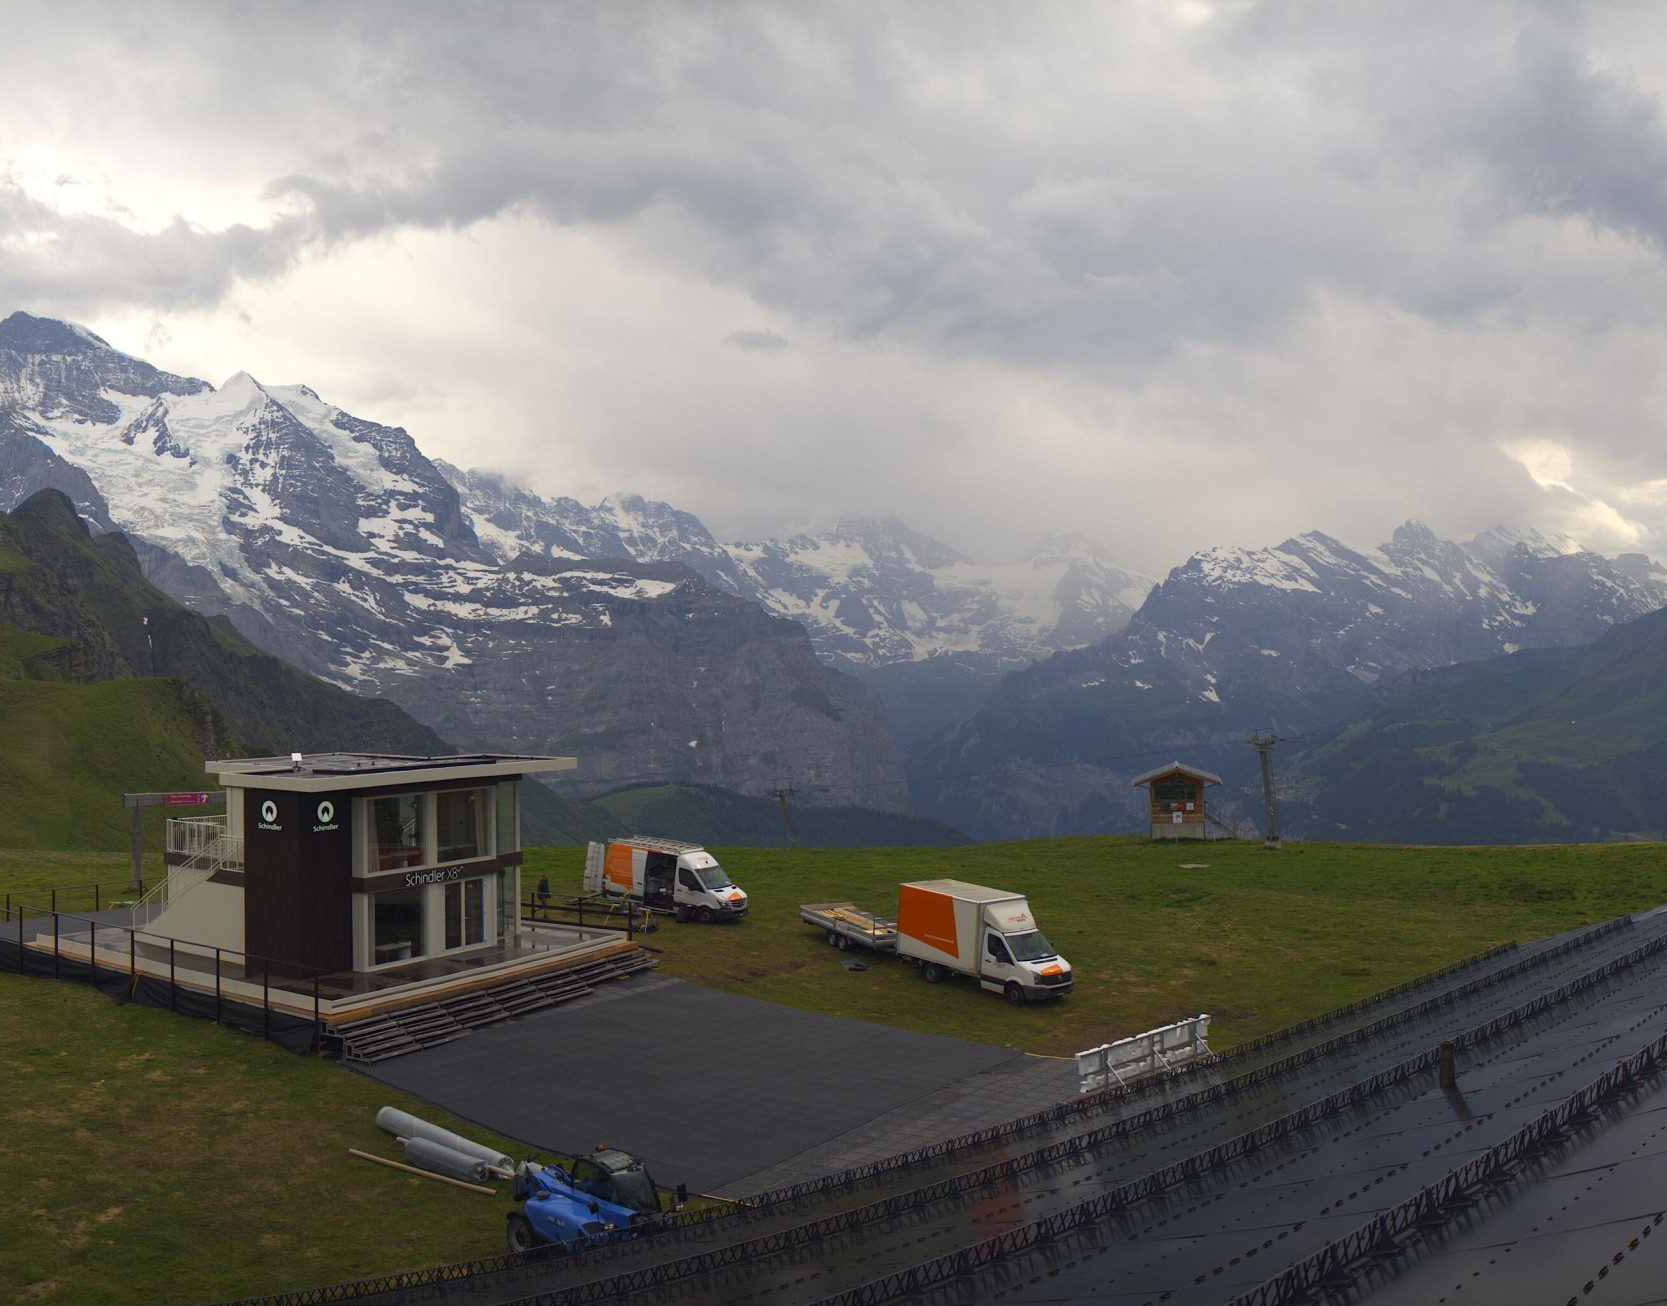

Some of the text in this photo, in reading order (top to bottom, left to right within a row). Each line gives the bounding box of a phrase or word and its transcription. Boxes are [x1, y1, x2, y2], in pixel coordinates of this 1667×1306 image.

[258, 822, 283, 831] Schindler
[312, 824, 339, 832] Schindler
[405, 869, 446, 887] Schindler
